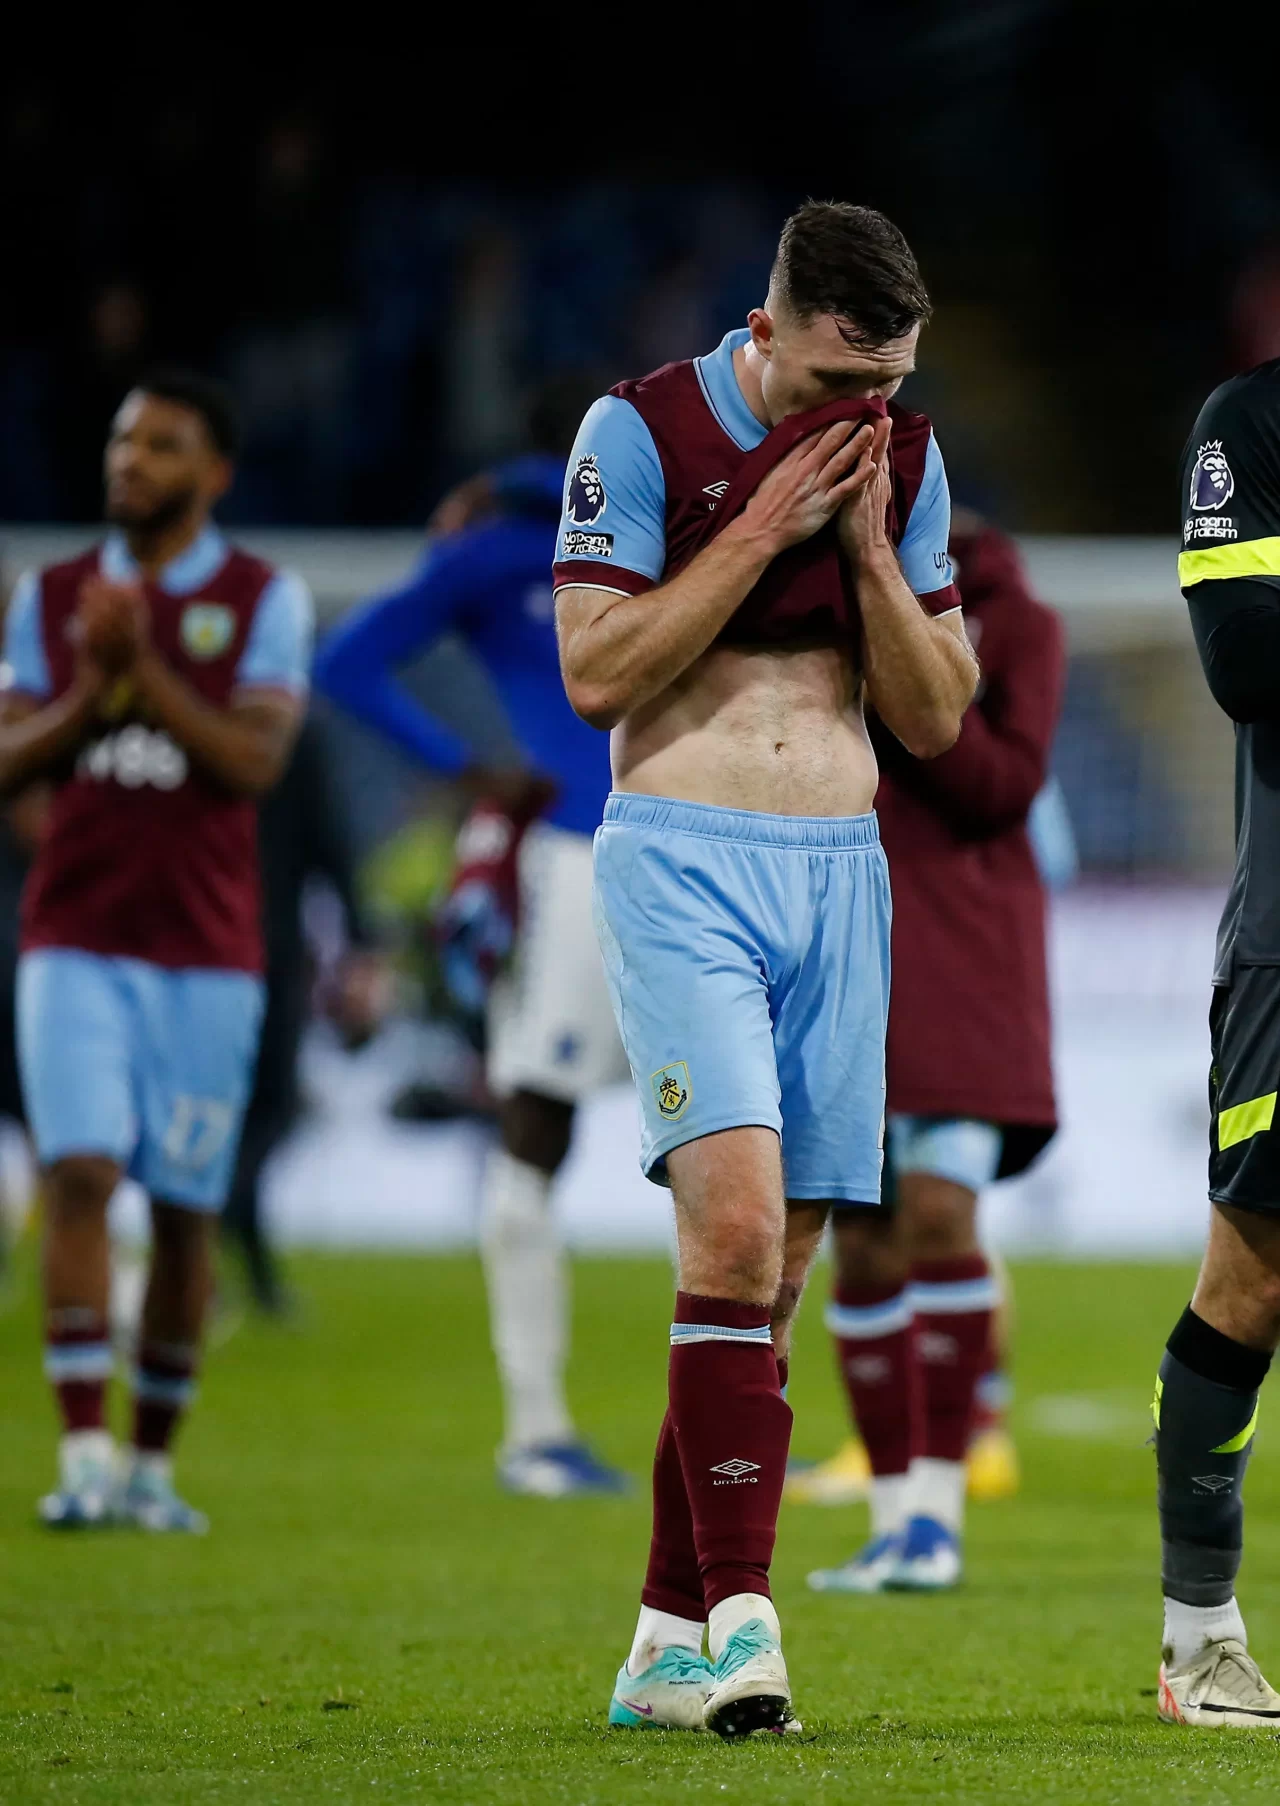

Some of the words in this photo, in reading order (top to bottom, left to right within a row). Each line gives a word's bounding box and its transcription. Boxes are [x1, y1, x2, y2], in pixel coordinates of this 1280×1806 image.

[1195, 516, 1233, 528] room
[1194, 527, 1238, 539] racism
[713, 1477, 759, 1486] umbro
